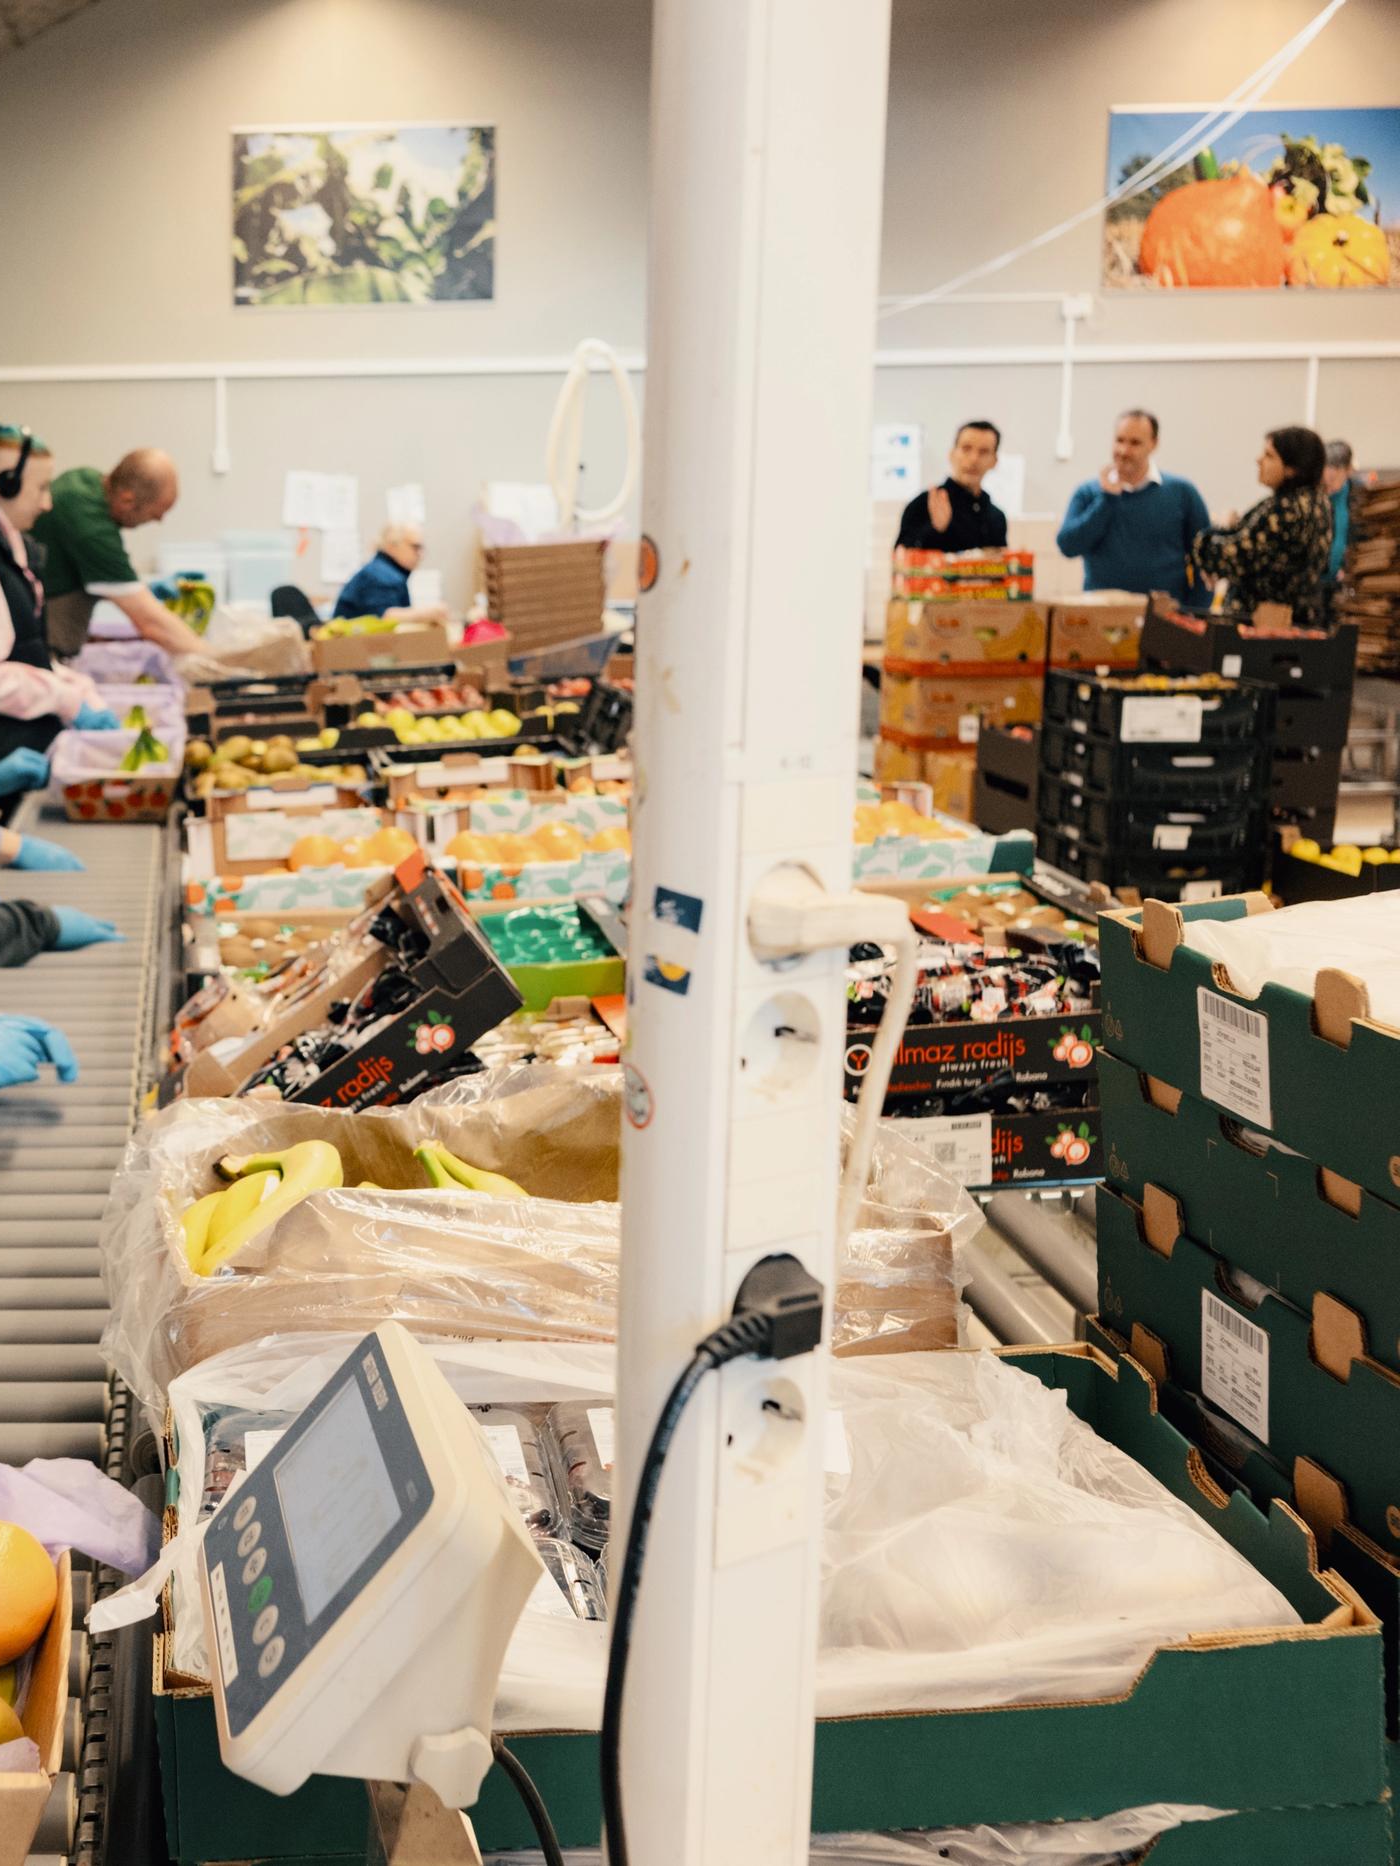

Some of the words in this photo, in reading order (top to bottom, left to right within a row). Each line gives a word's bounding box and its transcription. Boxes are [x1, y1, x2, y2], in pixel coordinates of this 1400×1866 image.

[940, 1062, 976, 1072] always
[981, 1059, 1008, 1069] fresh
[964, 1031, 1025, 1067] radijs
[337, 1056, 394, 1103] radijs
[992, 1128, 1023, 1163] dijs
